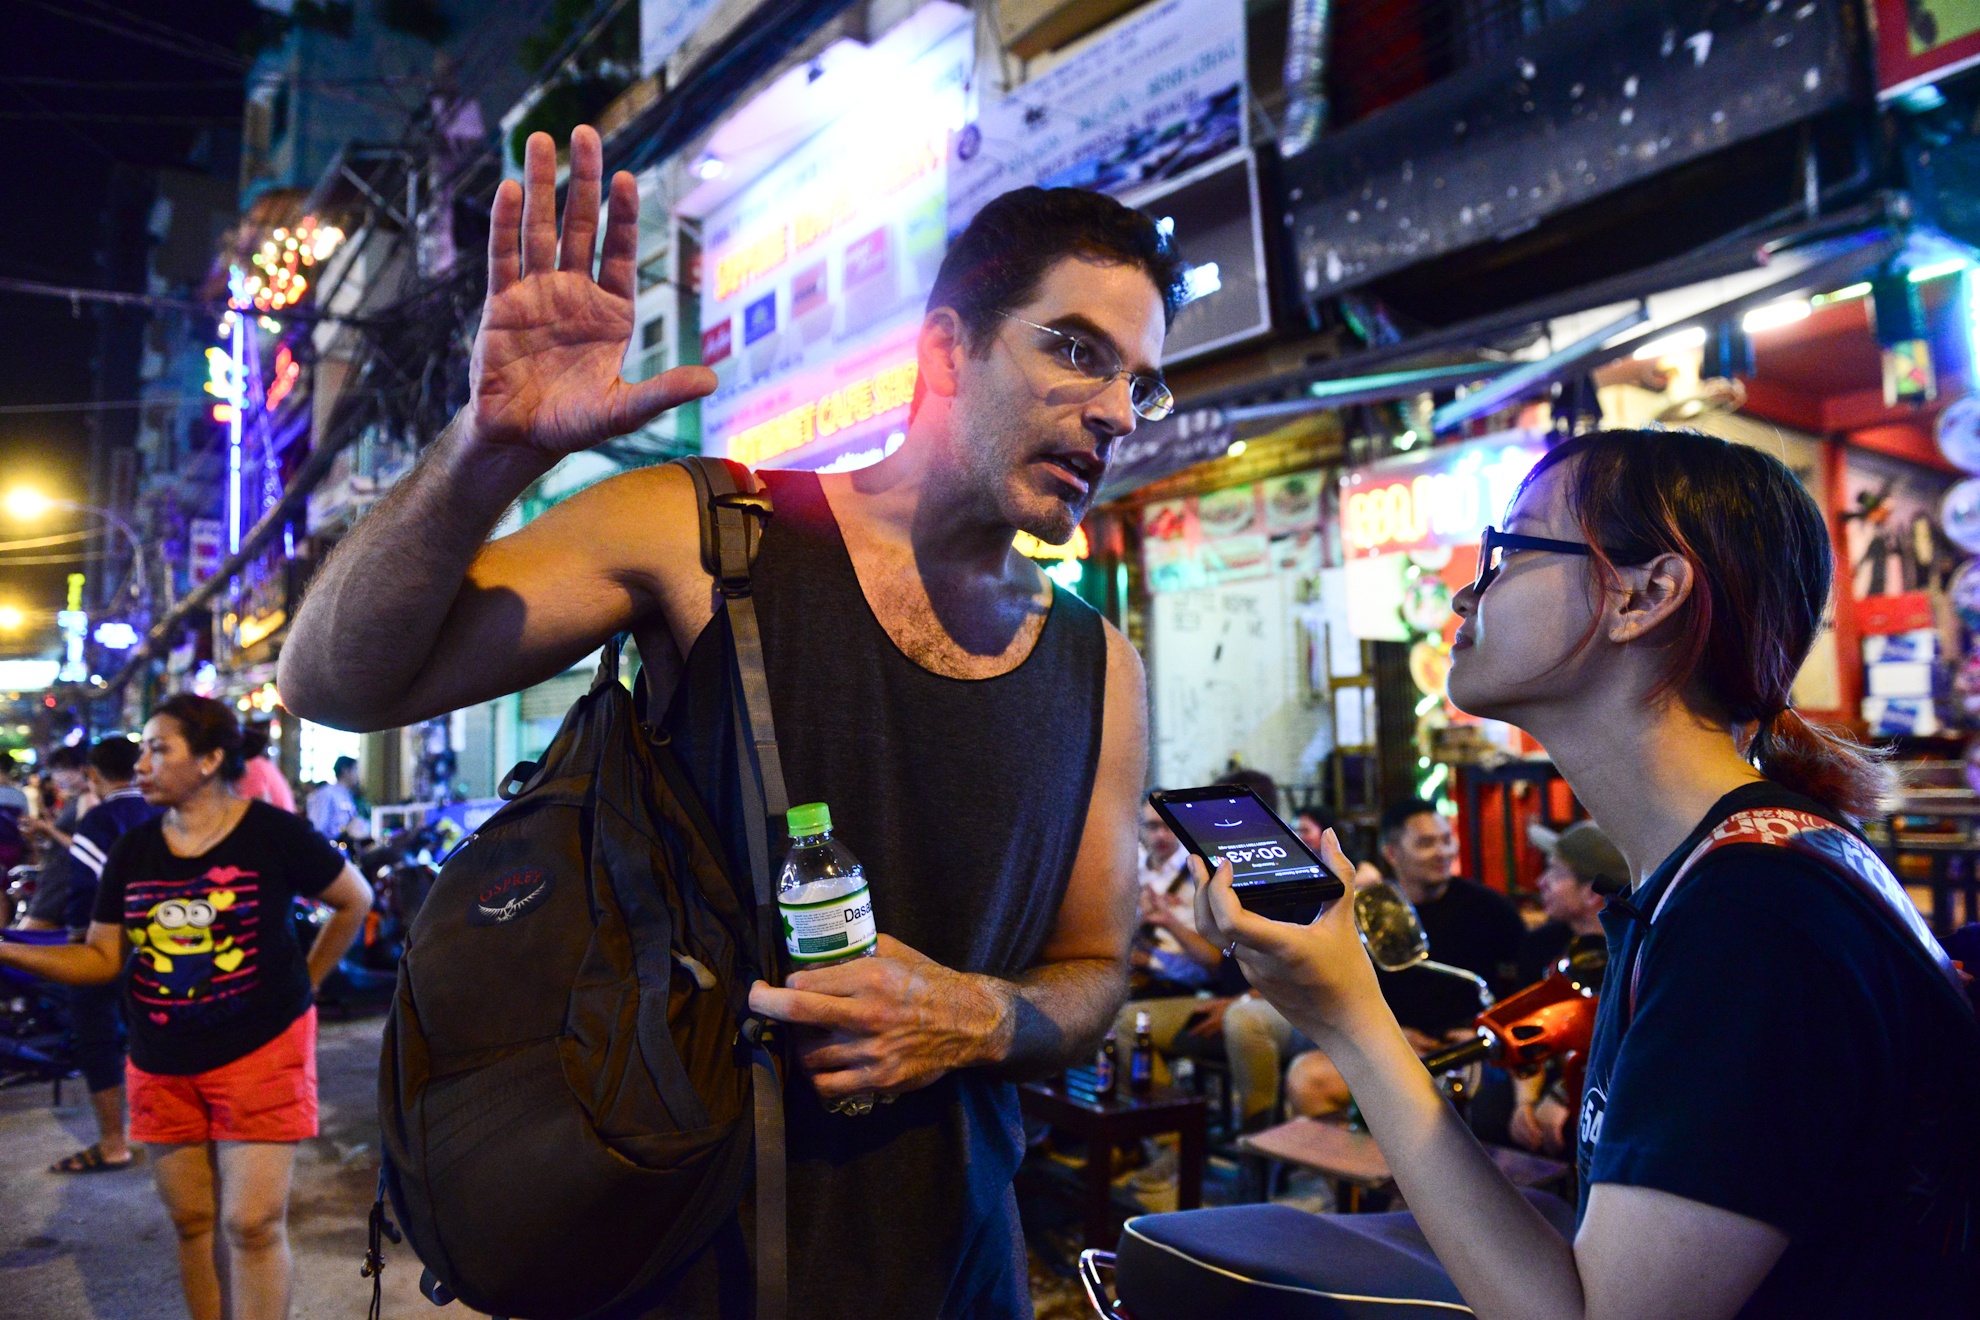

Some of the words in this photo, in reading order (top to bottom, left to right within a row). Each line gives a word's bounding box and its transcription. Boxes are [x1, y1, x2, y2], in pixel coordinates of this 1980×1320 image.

[871, 359, 919, 415] SHO
[1226, 847, 1287, 863] 00:43
[844, 900, 872, 923] Dasa
